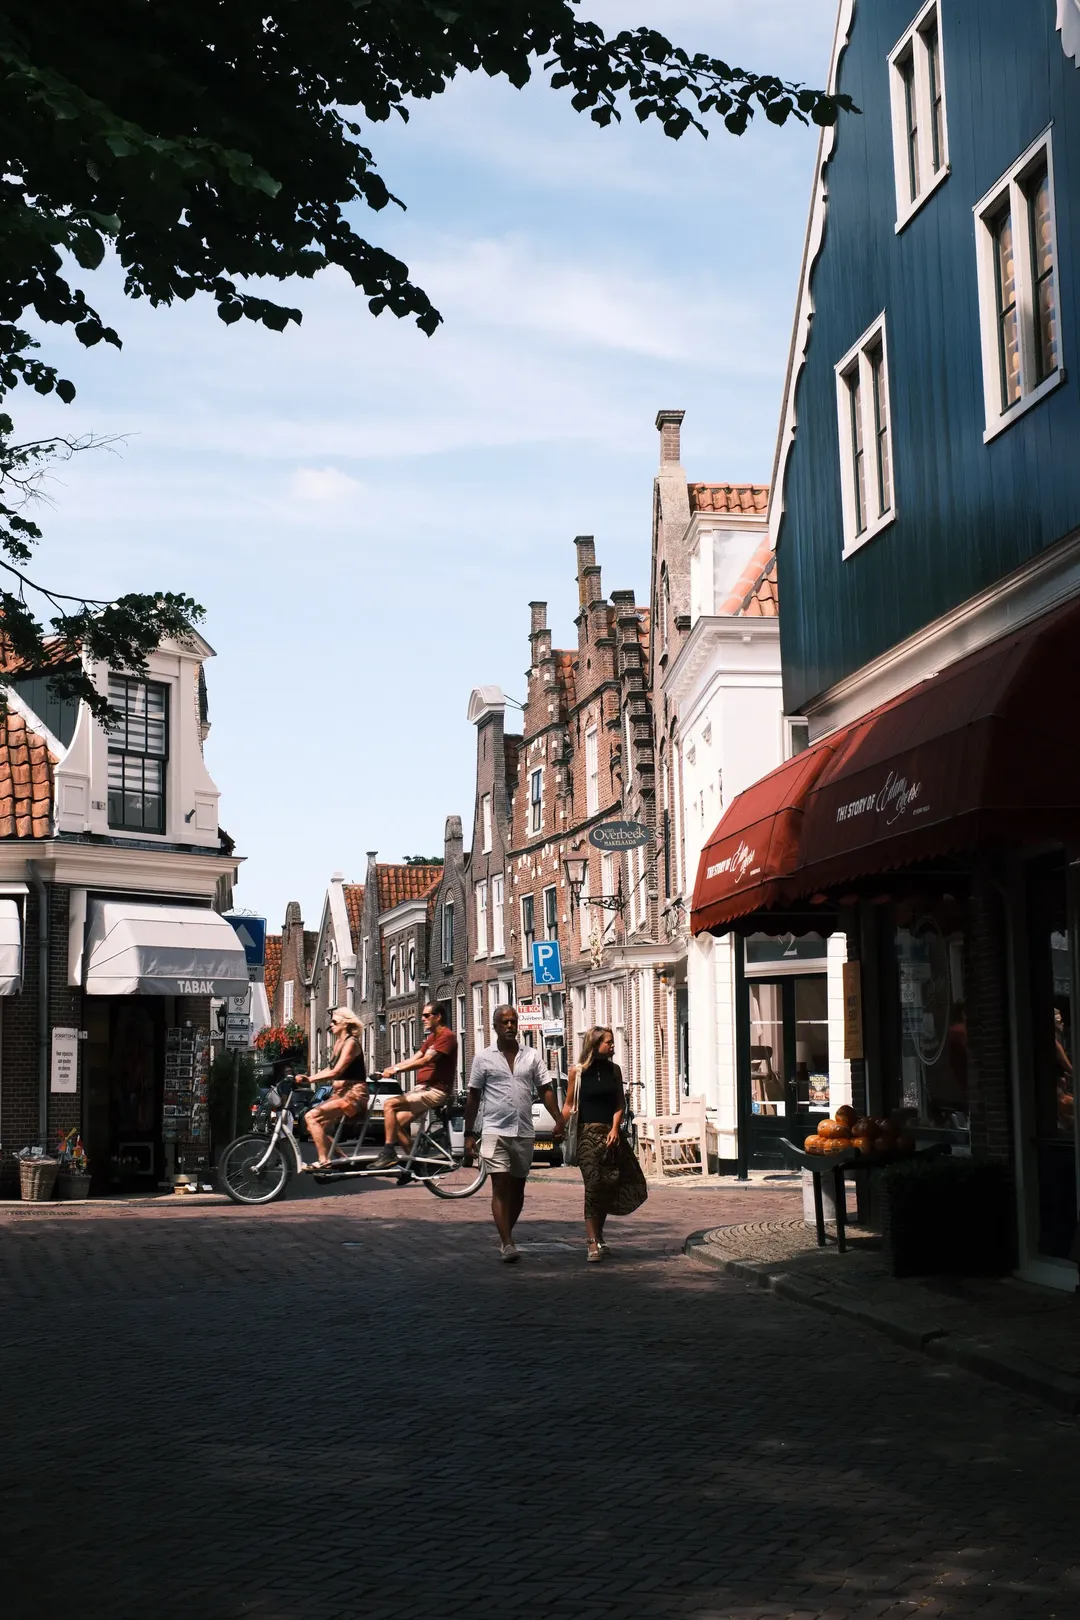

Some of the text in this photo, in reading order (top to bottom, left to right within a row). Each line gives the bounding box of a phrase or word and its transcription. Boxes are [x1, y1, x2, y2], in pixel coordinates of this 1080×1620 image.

[847, 796, 867, 818] STORY
[866, 793, 876, 811] OF
[593, 826, 646, 841] Overbeek
[783, 932, 797, 956] 2
[538, 945, 553, 966] P
[177, 980, 215, 994] TABAK
